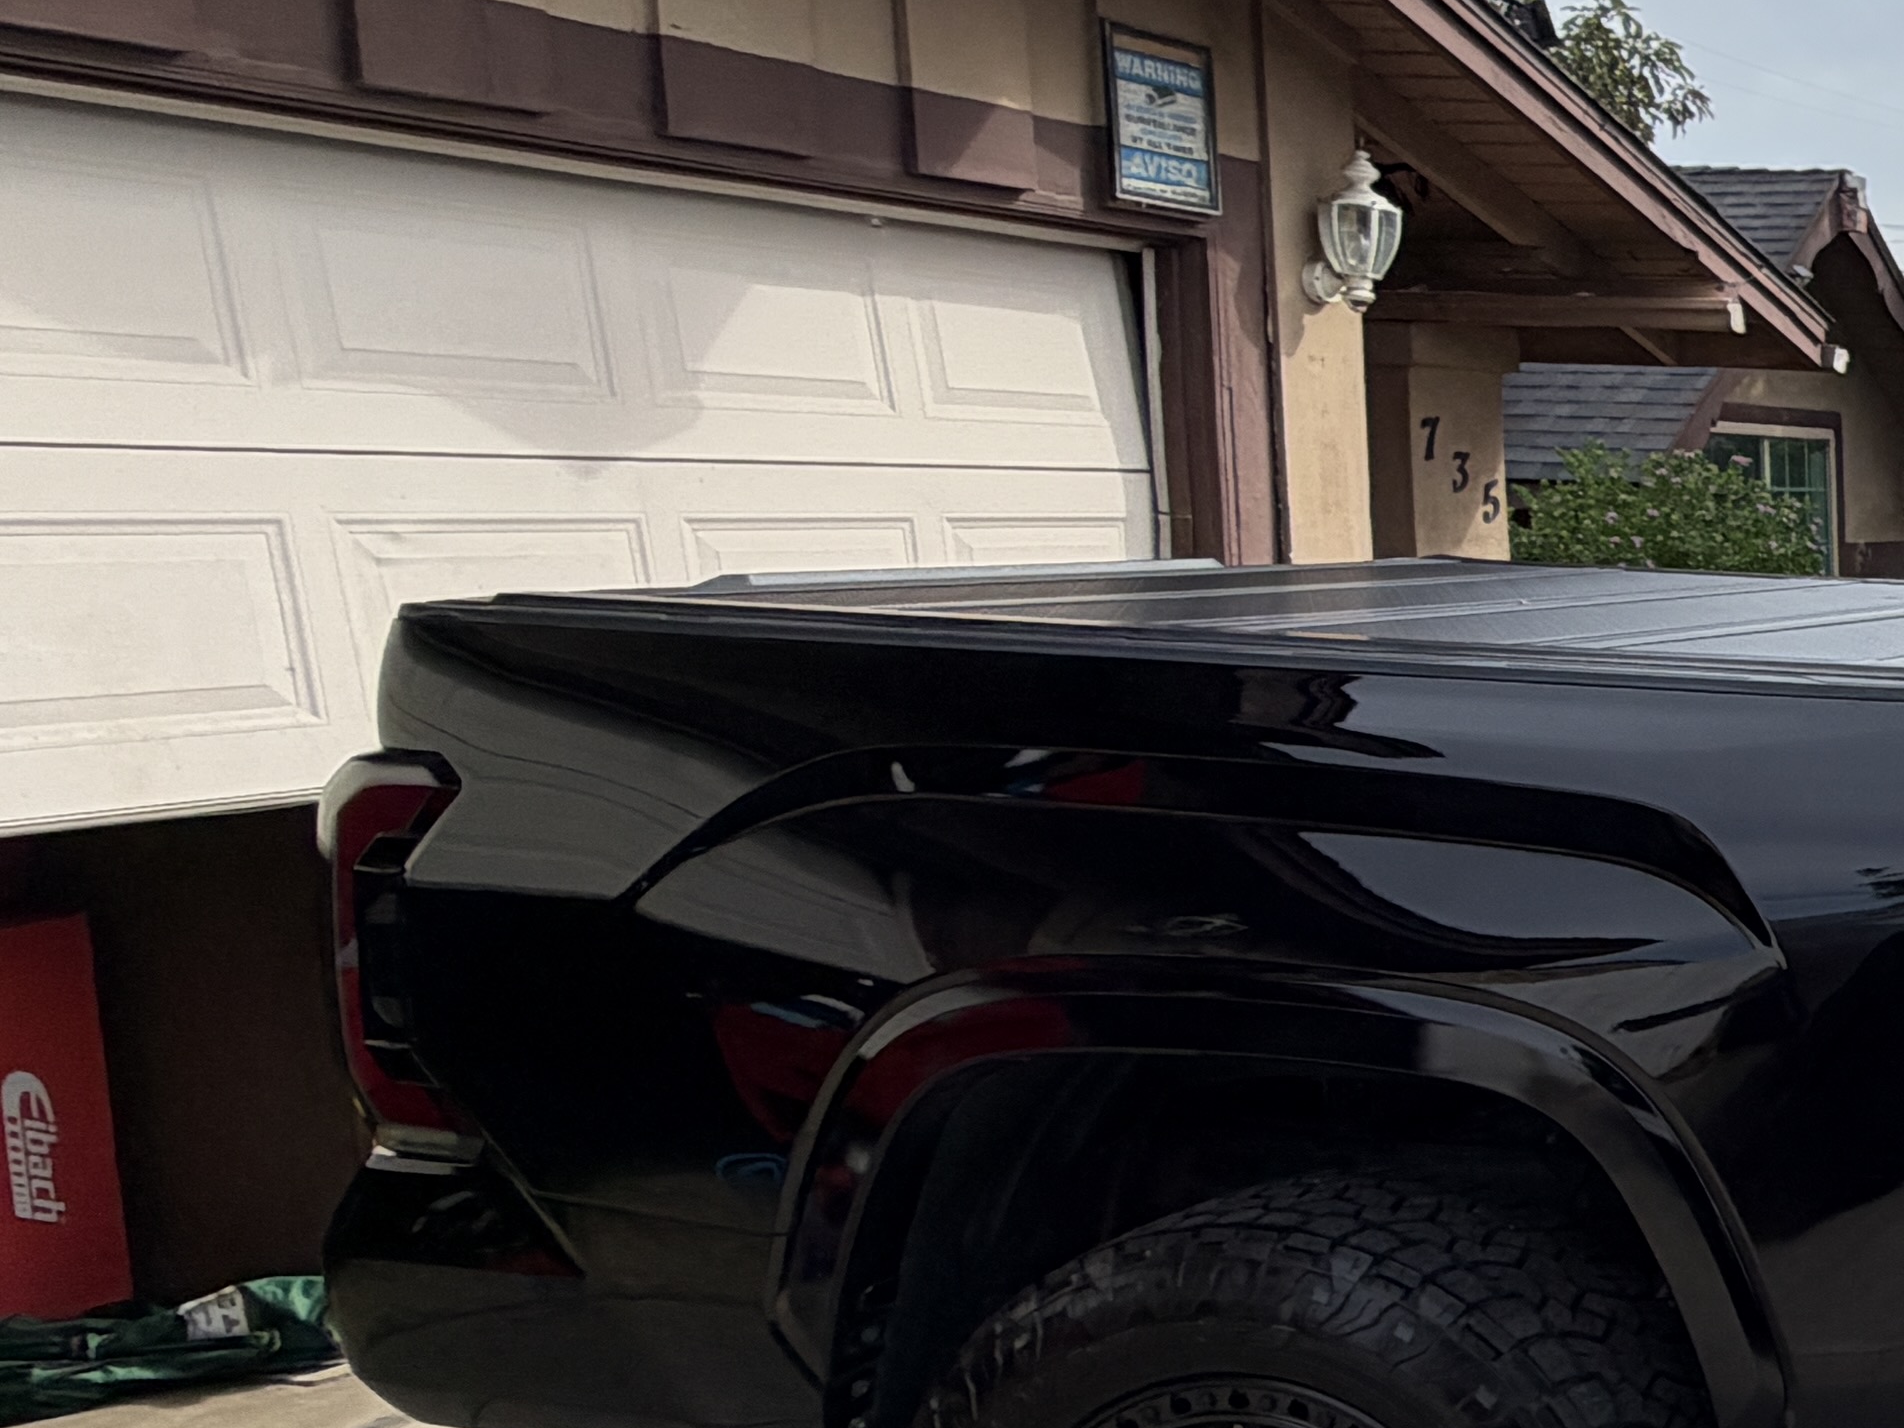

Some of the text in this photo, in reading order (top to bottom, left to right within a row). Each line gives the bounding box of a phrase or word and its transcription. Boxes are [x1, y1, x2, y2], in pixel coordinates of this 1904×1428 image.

[1114, 51, 1203, 91] WARNING
[1130, 152, 1198, 185] AVISO
[1420, 416, 1501, 524] 735
[1, 1070, 67, 1224] Eibach
